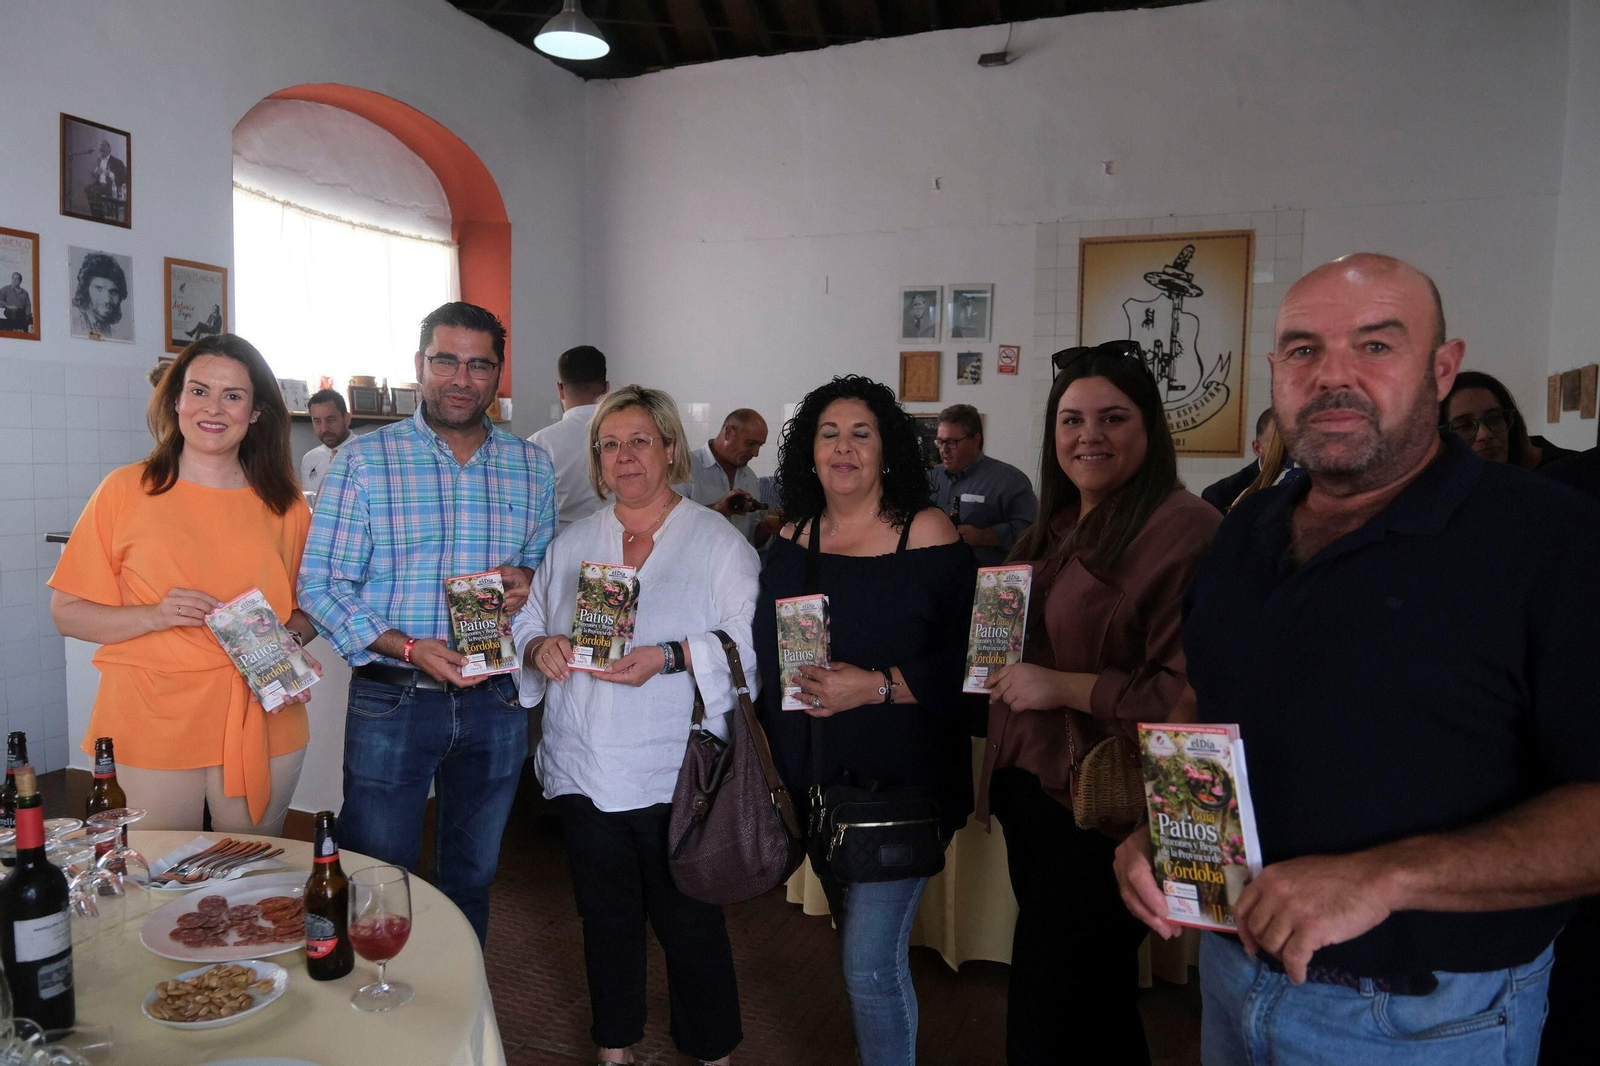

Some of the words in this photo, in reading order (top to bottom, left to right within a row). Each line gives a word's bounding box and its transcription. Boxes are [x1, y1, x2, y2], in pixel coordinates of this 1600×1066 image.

[1173, 438, 1185, 446] 81
[579, 608, 614, 625] Patios
[460, 617, 496, 632] Patios
[975, 622, 1009, 638] Patios
[463, 639, 500, 653] Córdoba
[576, 634, 612, 648] Córdoba
[238, 640, 279, 667] Patios
[783, 647, 814, 661] Patios
[972, 651, 1006, 665] Córdoba
[254, 662, 292, 687] Córdoba
[1157, 812, 1218, 842] Patios
[1163, 859, 1224, 884] Córdoba
